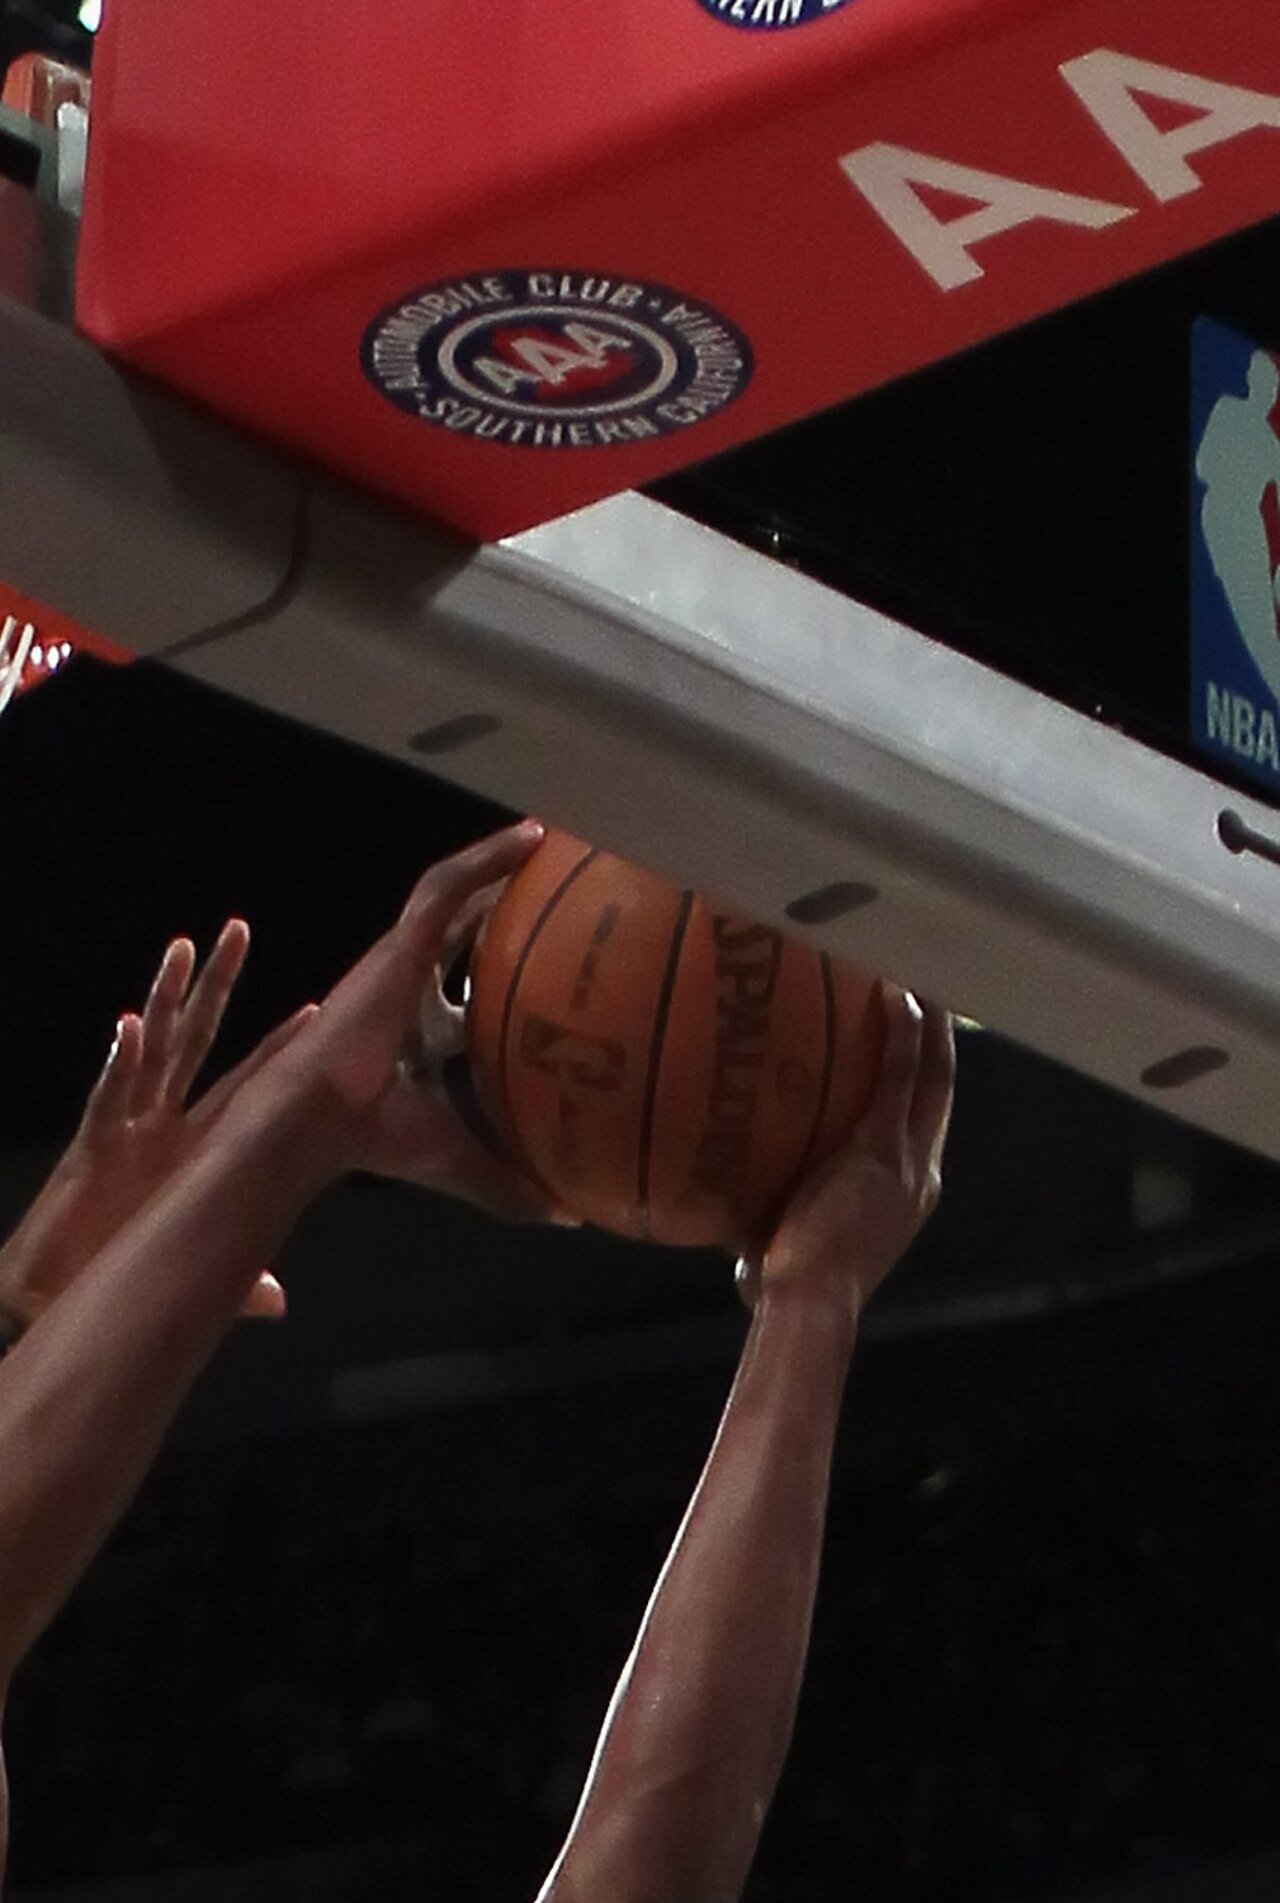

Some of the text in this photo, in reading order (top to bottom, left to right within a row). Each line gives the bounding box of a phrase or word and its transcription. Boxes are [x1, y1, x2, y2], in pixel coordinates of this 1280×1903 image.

[528, 272, 643, 309] CLUB
[473, 321, 632, 395] AAA
[421, 396, 660, 447] SOUTHERN
[1206, 681, 1280, 771] NBA
